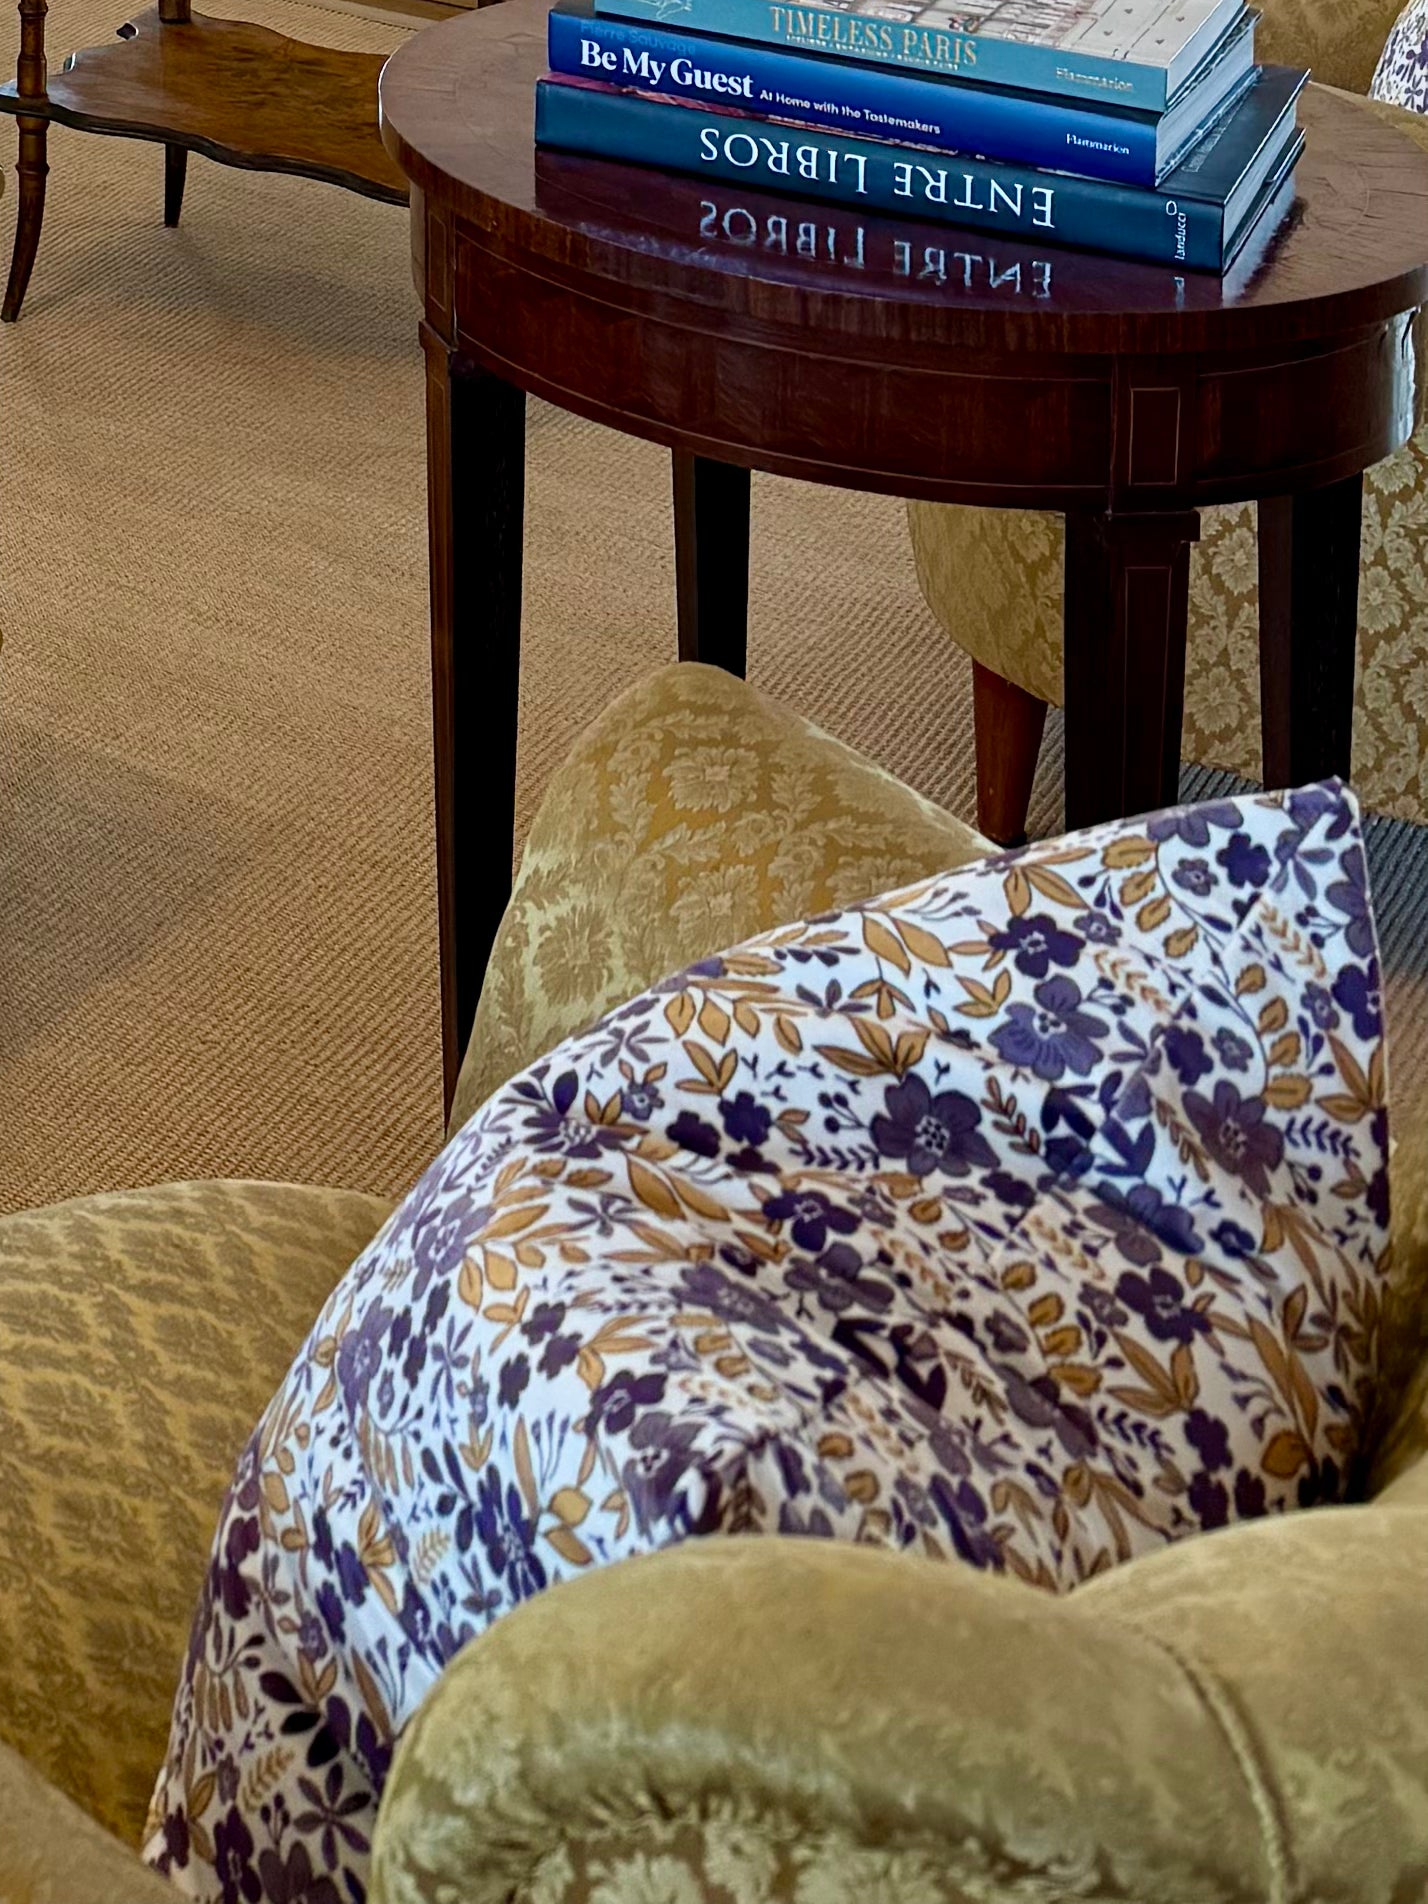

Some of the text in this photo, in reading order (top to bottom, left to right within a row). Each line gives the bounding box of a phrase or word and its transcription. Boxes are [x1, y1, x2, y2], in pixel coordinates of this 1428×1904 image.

[580, 19, 625, 41] Pierre
[770, 5, 894, 52] TIMELESS
[902, 28, 978, 67] PARIS
[579, 39, 754, 99] Be My Guest
[1055, 66, 1135, 91] Flammarion
[759, 89, 942, 135] At Home with the Tastemakers
[1065, 133, 1131, 155] Flammarion
[699, 127, 1056, 229] ENTRE LIBROS
